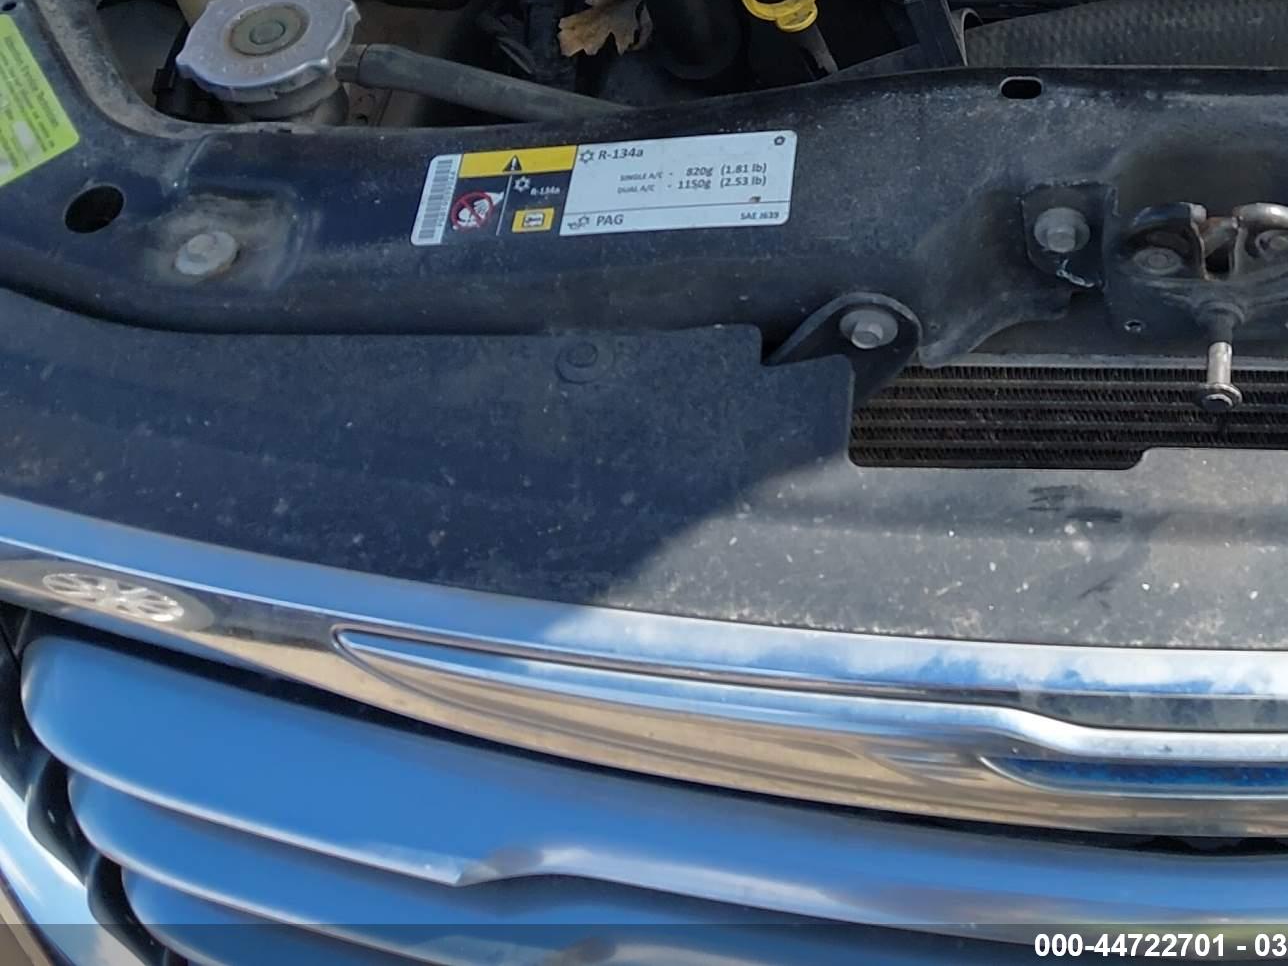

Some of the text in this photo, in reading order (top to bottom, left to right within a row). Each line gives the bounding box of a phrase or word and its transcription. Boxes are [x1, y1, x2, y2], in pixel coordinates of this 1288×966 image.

[598, 147, 644, 161] R-134a
[620, 173, 648, 182] SINGLE
[649, 171, 663, 180] A/C
[686, 166, 713, 177] 820g
[721, 164, 748, 175] (1.81
[751, 162, 767, 174] lb)
[530, 186, 561, 196] R-134a
[617, 186, 639, 194] DUAL
[640, 184, 654, 193] A/C
[678, 179, 712, 190] 1150g
[720, 176, 748, 188] (2.53
[751, 175, 767, 187] lb)
[596, 214, 624, 227] PAG
[740, 211, 757, 220] SAE
